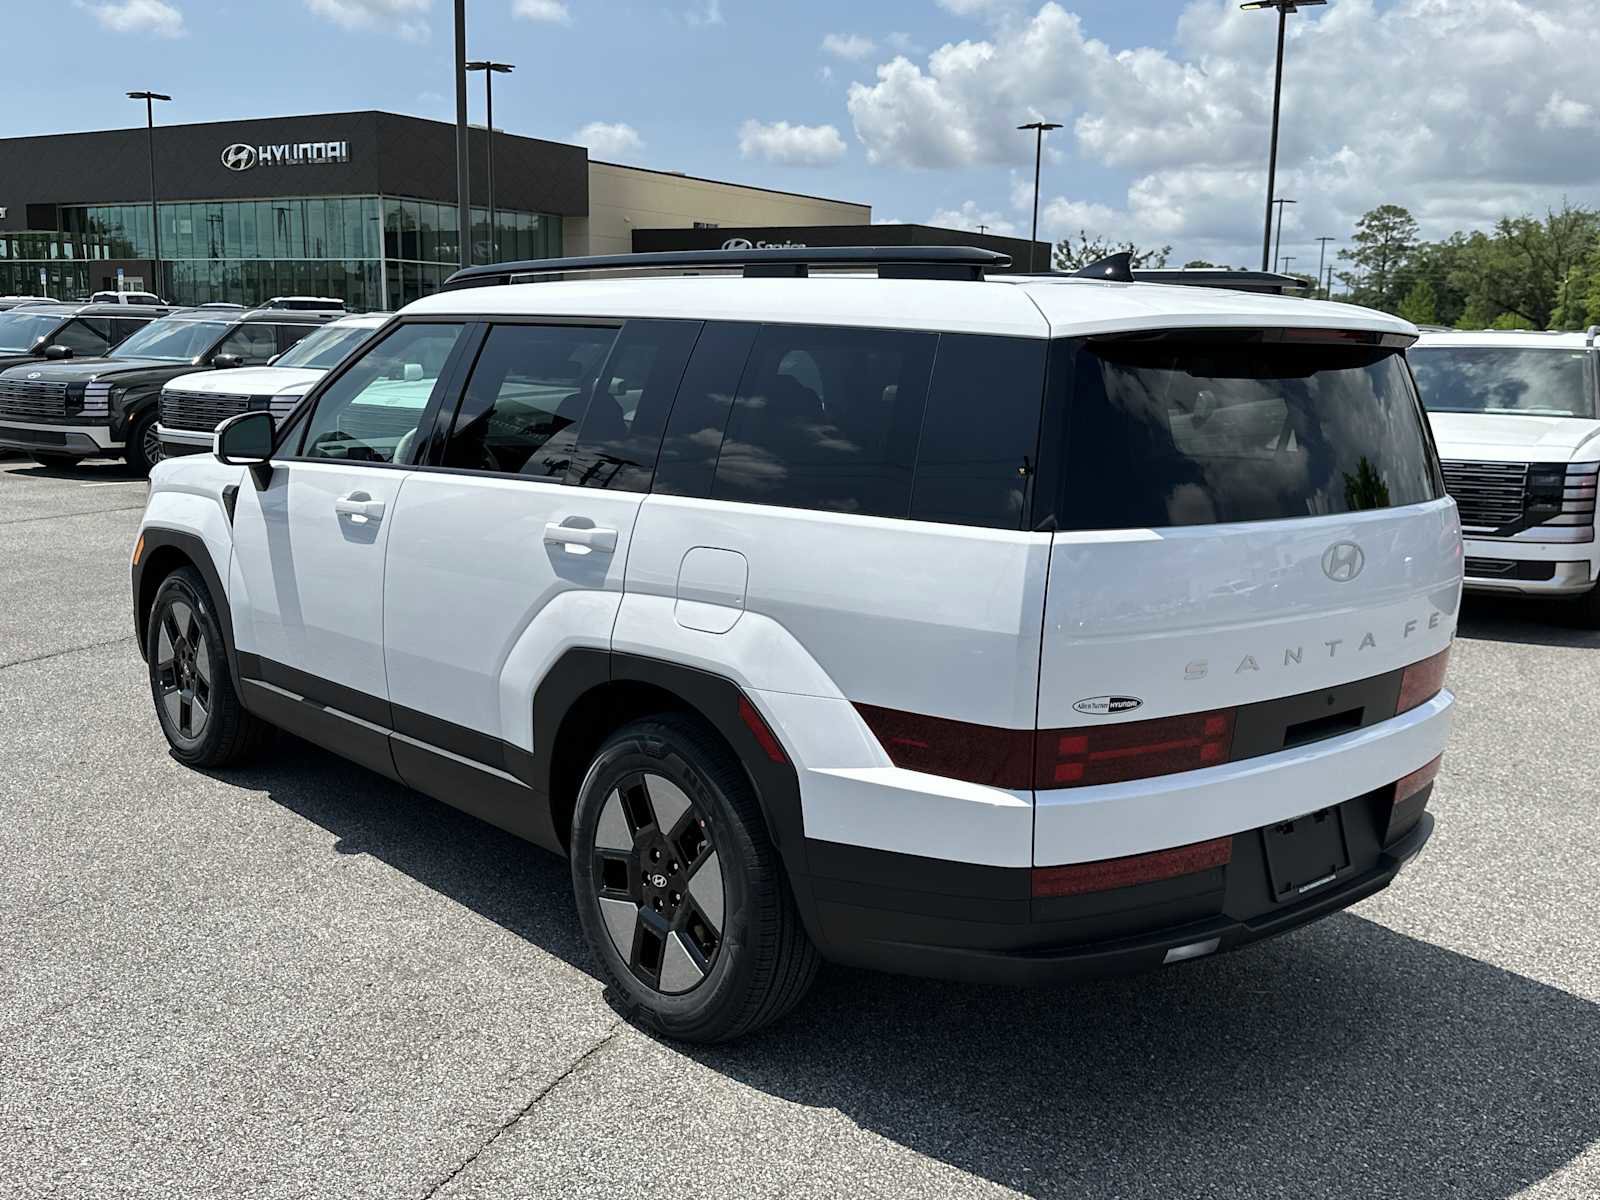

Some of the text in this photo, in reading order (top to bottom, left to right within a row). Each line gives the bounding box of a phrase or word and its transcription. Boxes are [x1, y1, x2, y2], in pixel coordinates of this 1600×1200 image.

[258, 141, 347, 162] HYUNDAI
[1184, 612, 1440, 680] SANTA FE
